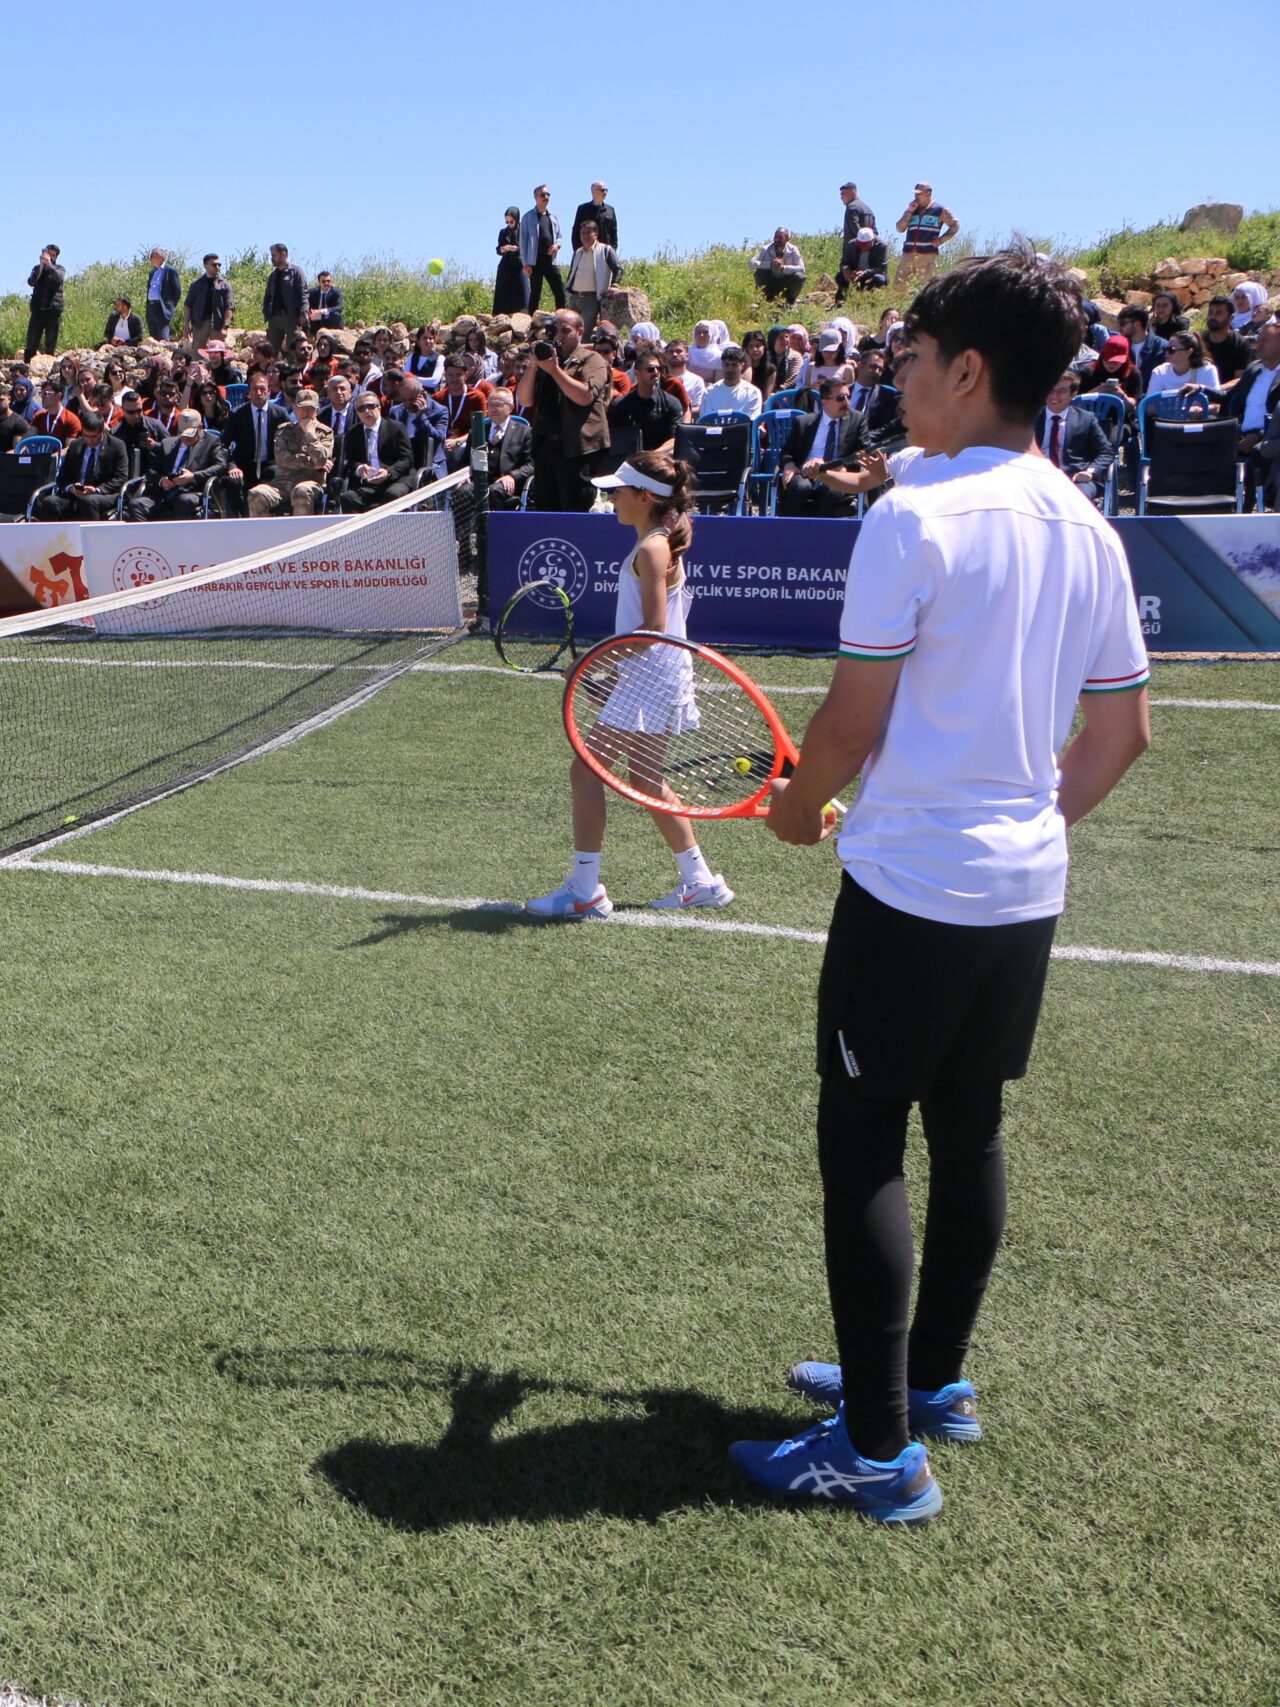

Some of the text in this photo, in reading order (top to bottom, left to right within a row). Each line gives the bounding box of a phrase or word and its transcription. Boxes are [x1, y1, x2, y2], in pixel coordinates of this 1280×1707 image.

[277, 561, 296, 574] VE
[302, 560, 340, 573] SPOR
[344, 555, 426, 572] BAKANLIĞI
[594, 561, 620, 575] T.C
[709, 564, 732, 579] VE
[737, 565, 782, 581] SPOR
[786, 567, 847, 583] BAKAN
[245, 580, 291, 593] GENÇLİK
[293, 580, 308, 590] VE
[310, 579, 339, 590] SPOR
[353, 575, 428, 588] MÜDÜRLÜĞÜ
[684, 583, 845, 601] NÇLİK VE SPOR İL MÜDÜR
